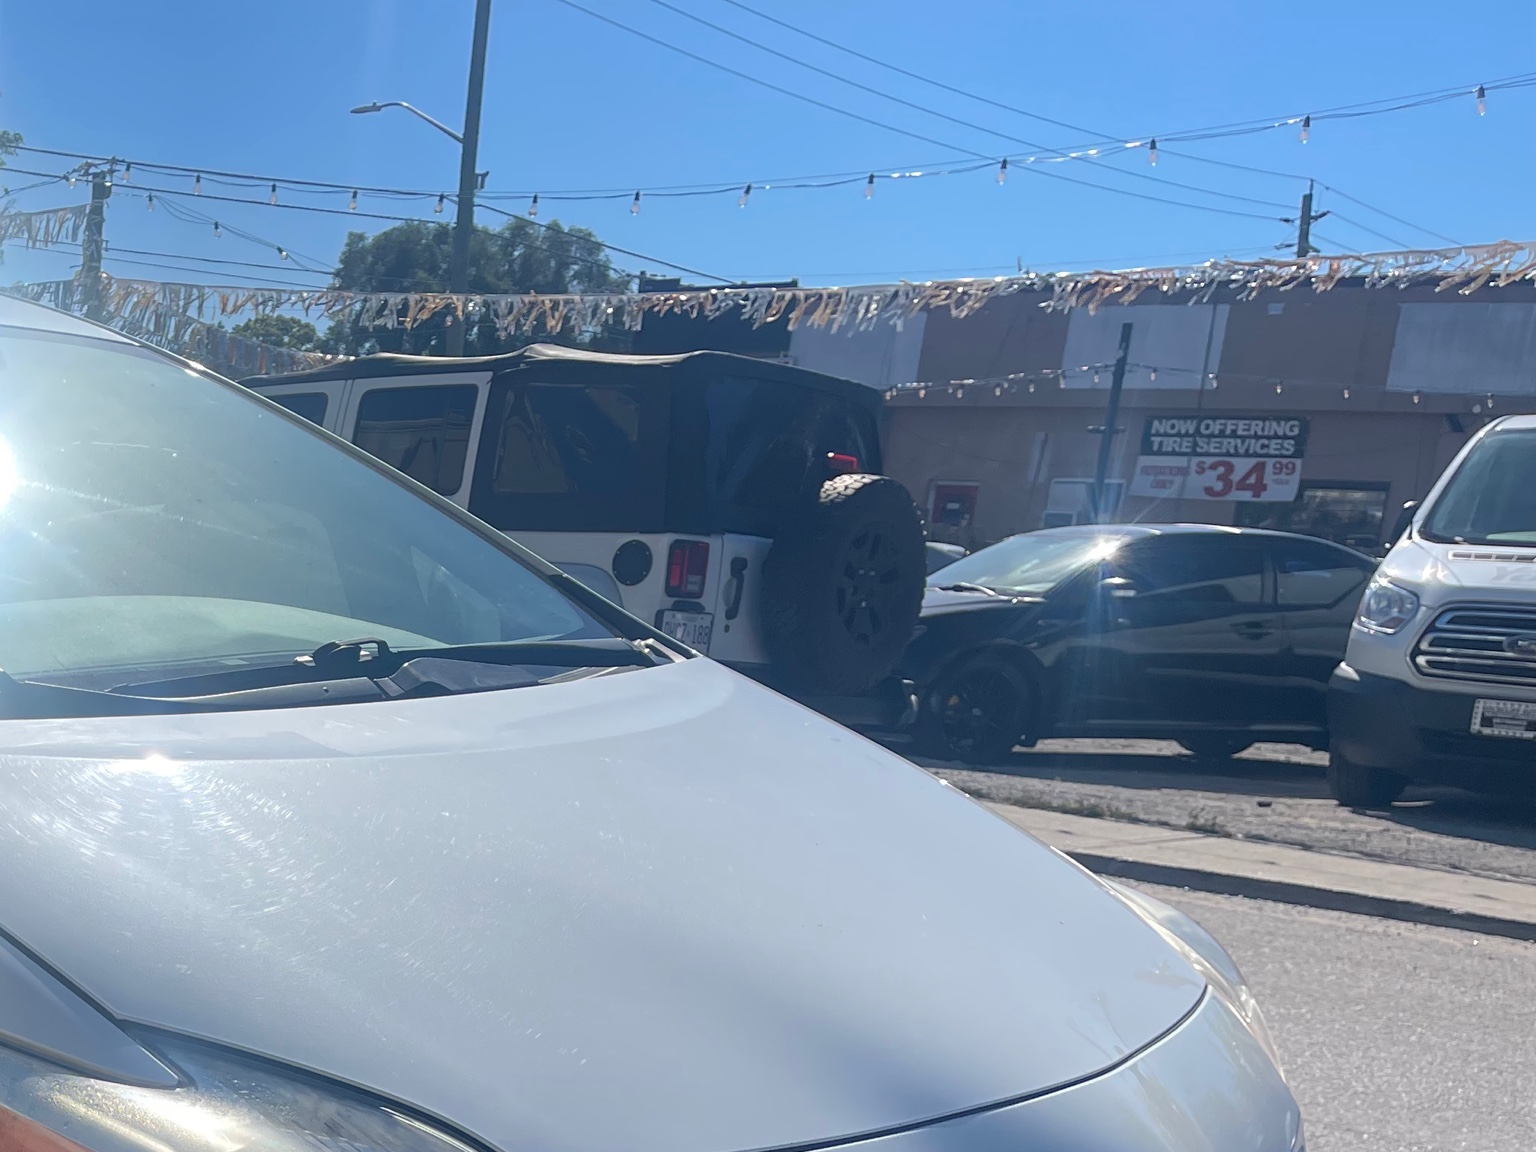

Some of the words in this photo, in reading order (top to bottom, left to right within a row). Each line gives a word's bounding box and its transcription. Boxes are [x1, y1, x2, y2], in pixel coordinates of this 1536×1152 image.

[1151, 418, 1197, 435] NOW
[1199, 419, 1300, 437] OFFERING
[1150, 436, 1192, 453] TIRE
[1196, 437, 1296, 456] SERVICES
